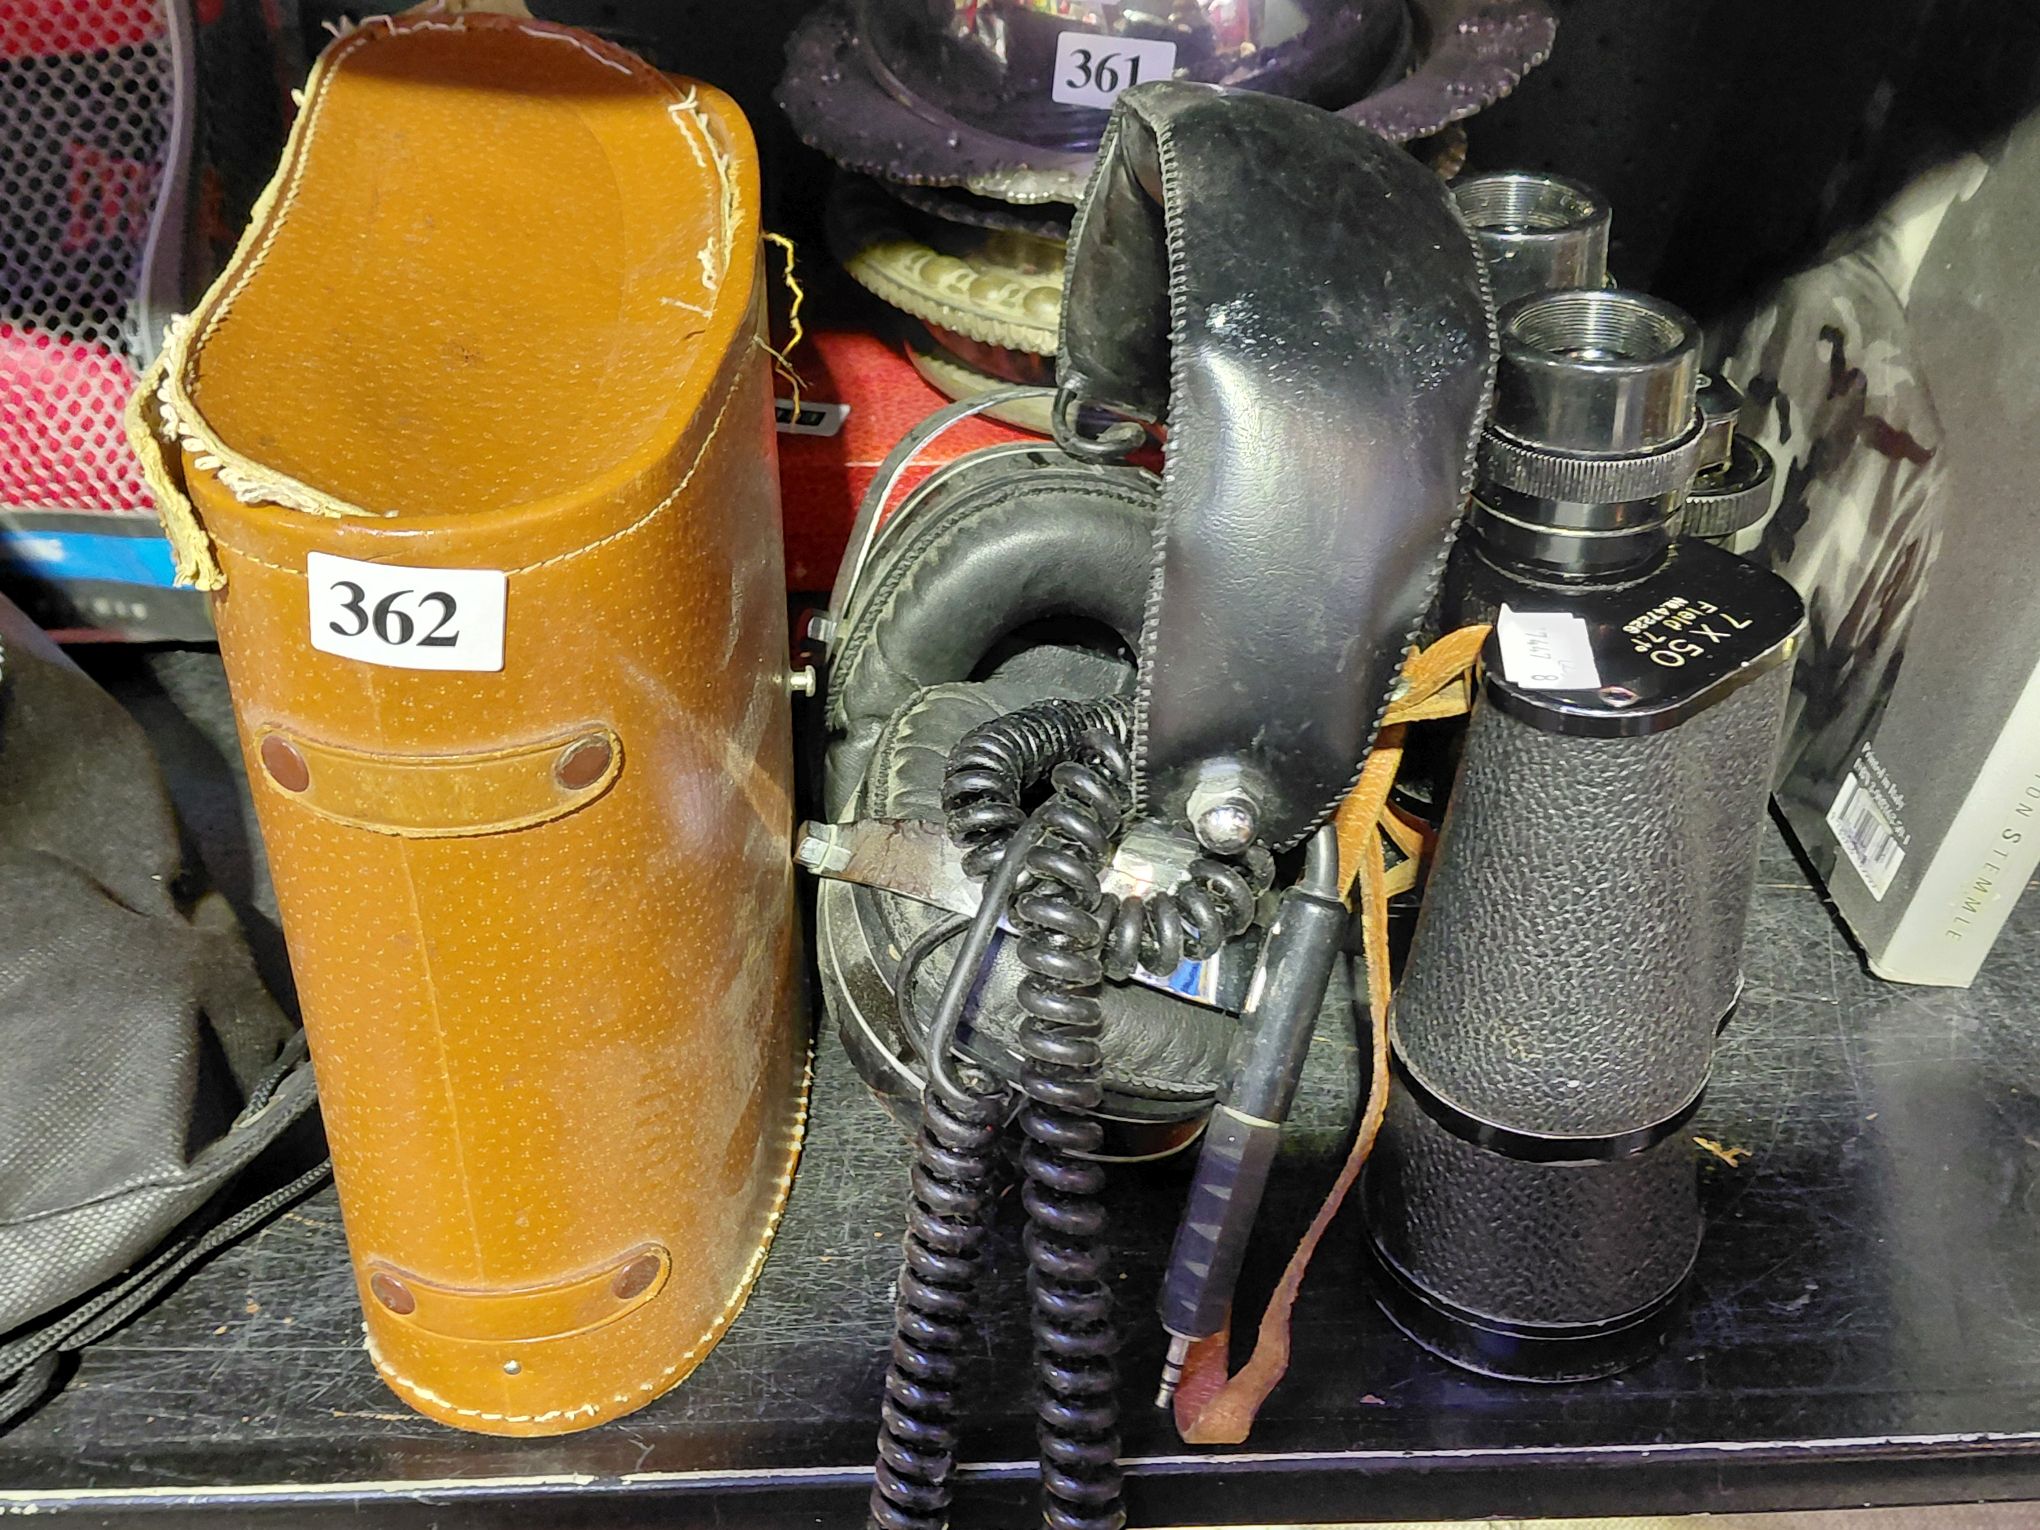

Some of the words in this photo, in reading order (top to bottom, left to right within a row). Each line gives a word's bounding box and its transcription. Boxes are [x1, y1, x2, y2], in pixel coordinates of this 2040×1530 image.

[1065, 48, 1141, 93] 361
[329, 580, 460, 647] 362
[1662, 600, 1719, 631] Field
[1719, 613, 1753, 629] 7
[1650, 639, 1705, 667] 50
[1946, 828, 2022, 943] STEMMLE
